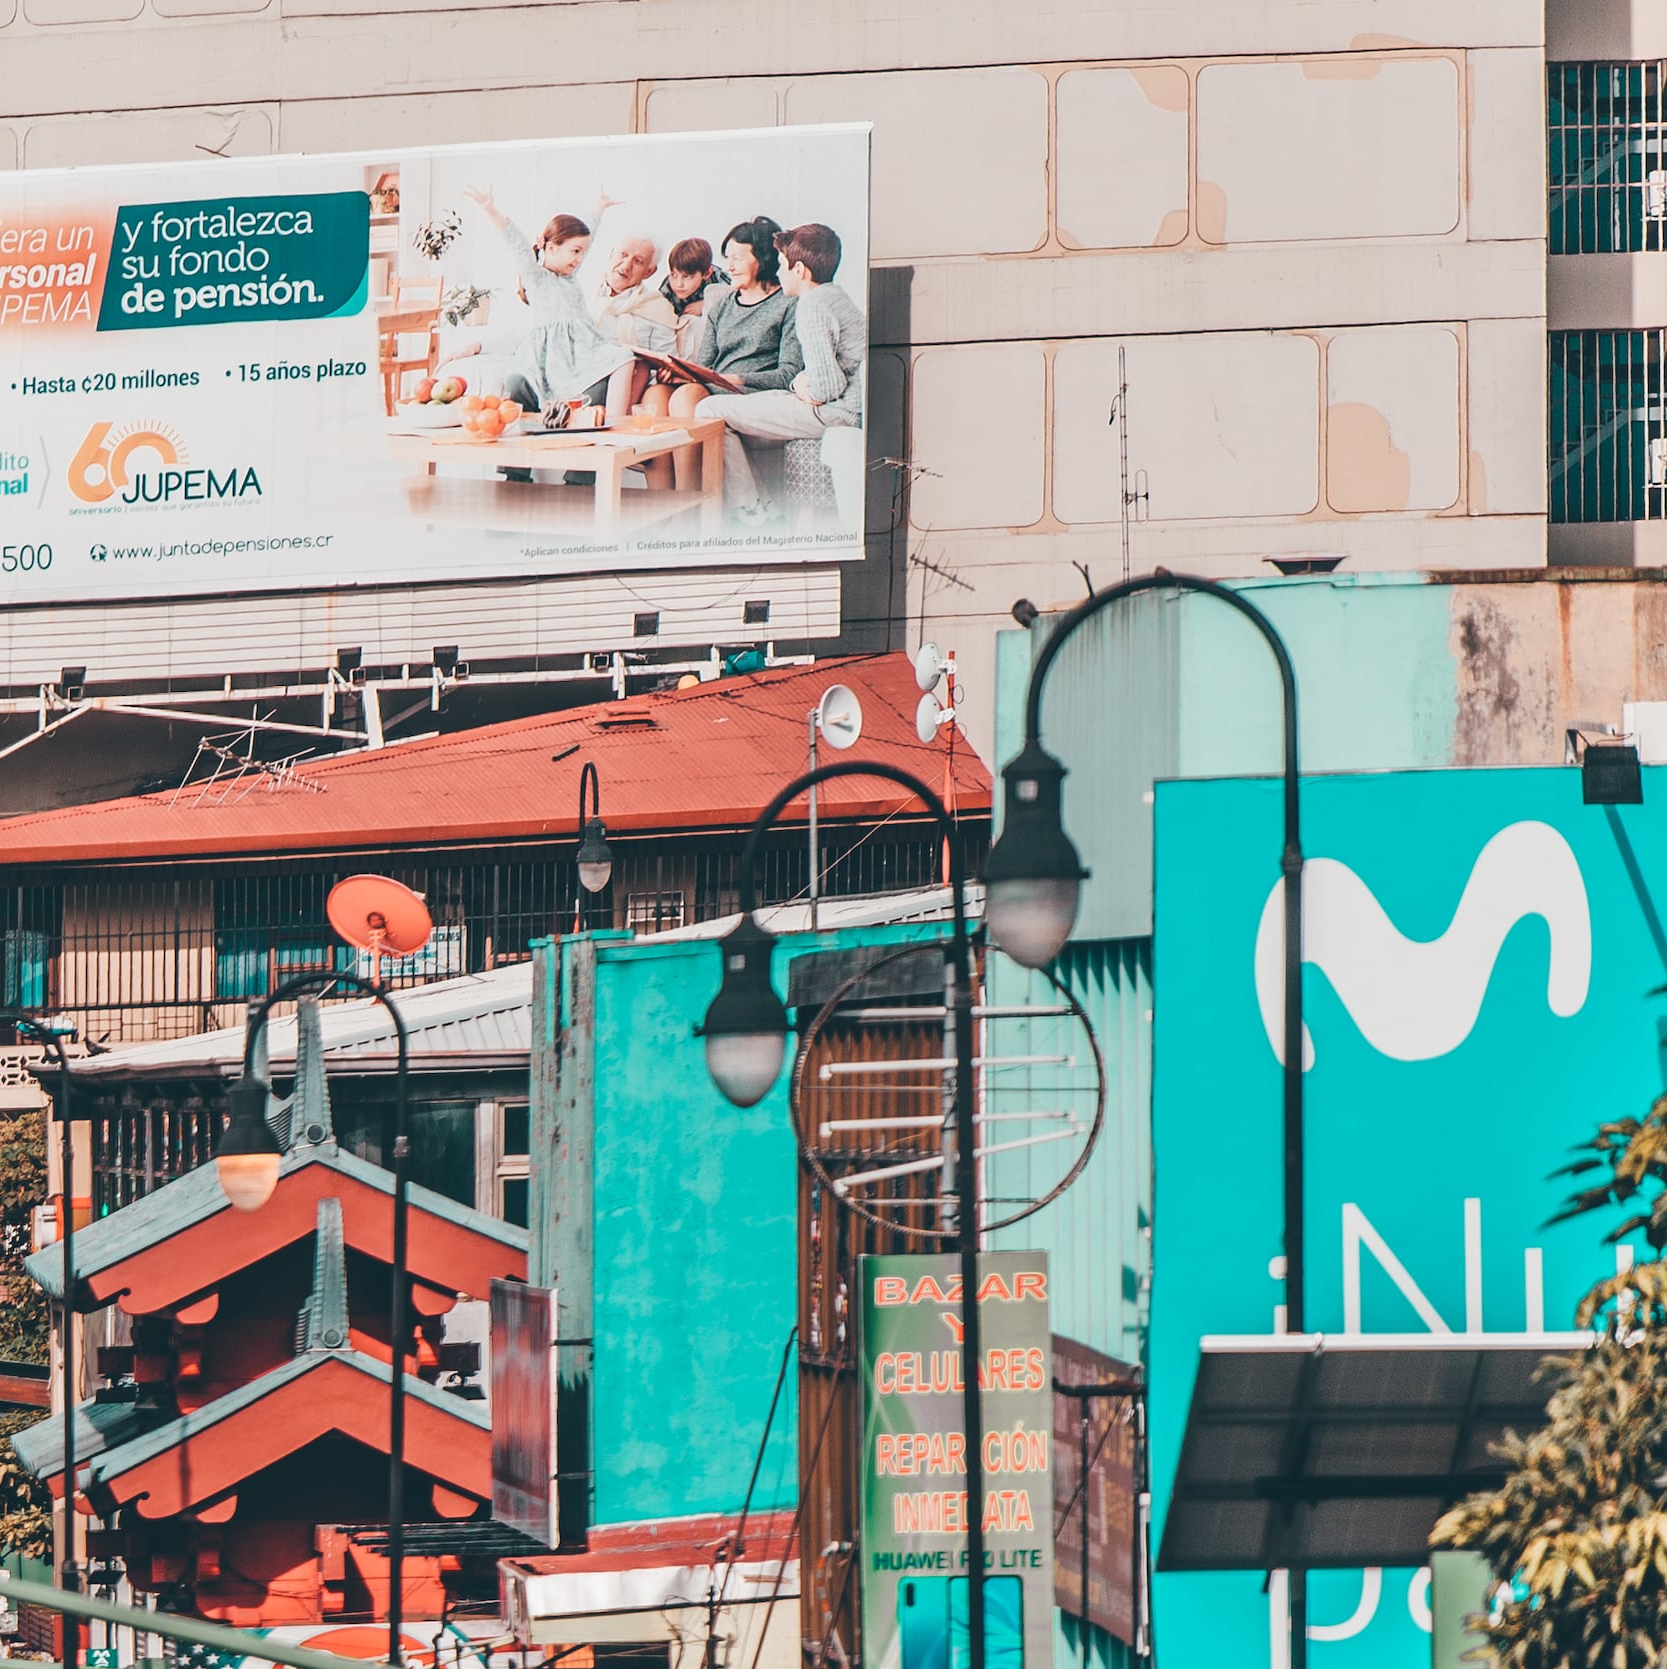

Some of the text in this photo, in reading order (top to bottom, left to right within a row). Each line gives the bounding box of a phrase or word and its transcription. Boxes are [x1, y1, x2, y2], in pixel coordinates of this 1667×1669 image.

[55, 224, 95, 252] un
[121, 207, 313, 252] y fortalezca
[121, 242, 270, 279] su fondo
[120, 273, 325, 318] de pensión.
[22, 374, 76, 396] Hasta
[120, 368, 200, 391] millones
[237, 359, 367, 383] 15 años plazo
[122, 466, 263, 504] JUPEMA
[113, 532, 334, 562] www.juntadepensiones.cr
[561, 543, 619, 555] condiciones
[637, 532, 857, 551] Créditos para afiliados del Magisterio Nacional
[875, 1272, 1048, 1306] BAZAR
[875, 1421, 1048, 1475] REPARCIÓN
[894, 1490, 1034, 1533] INMEDATA
[873, 1549, 1043, 1571] HUAWEI LITE
